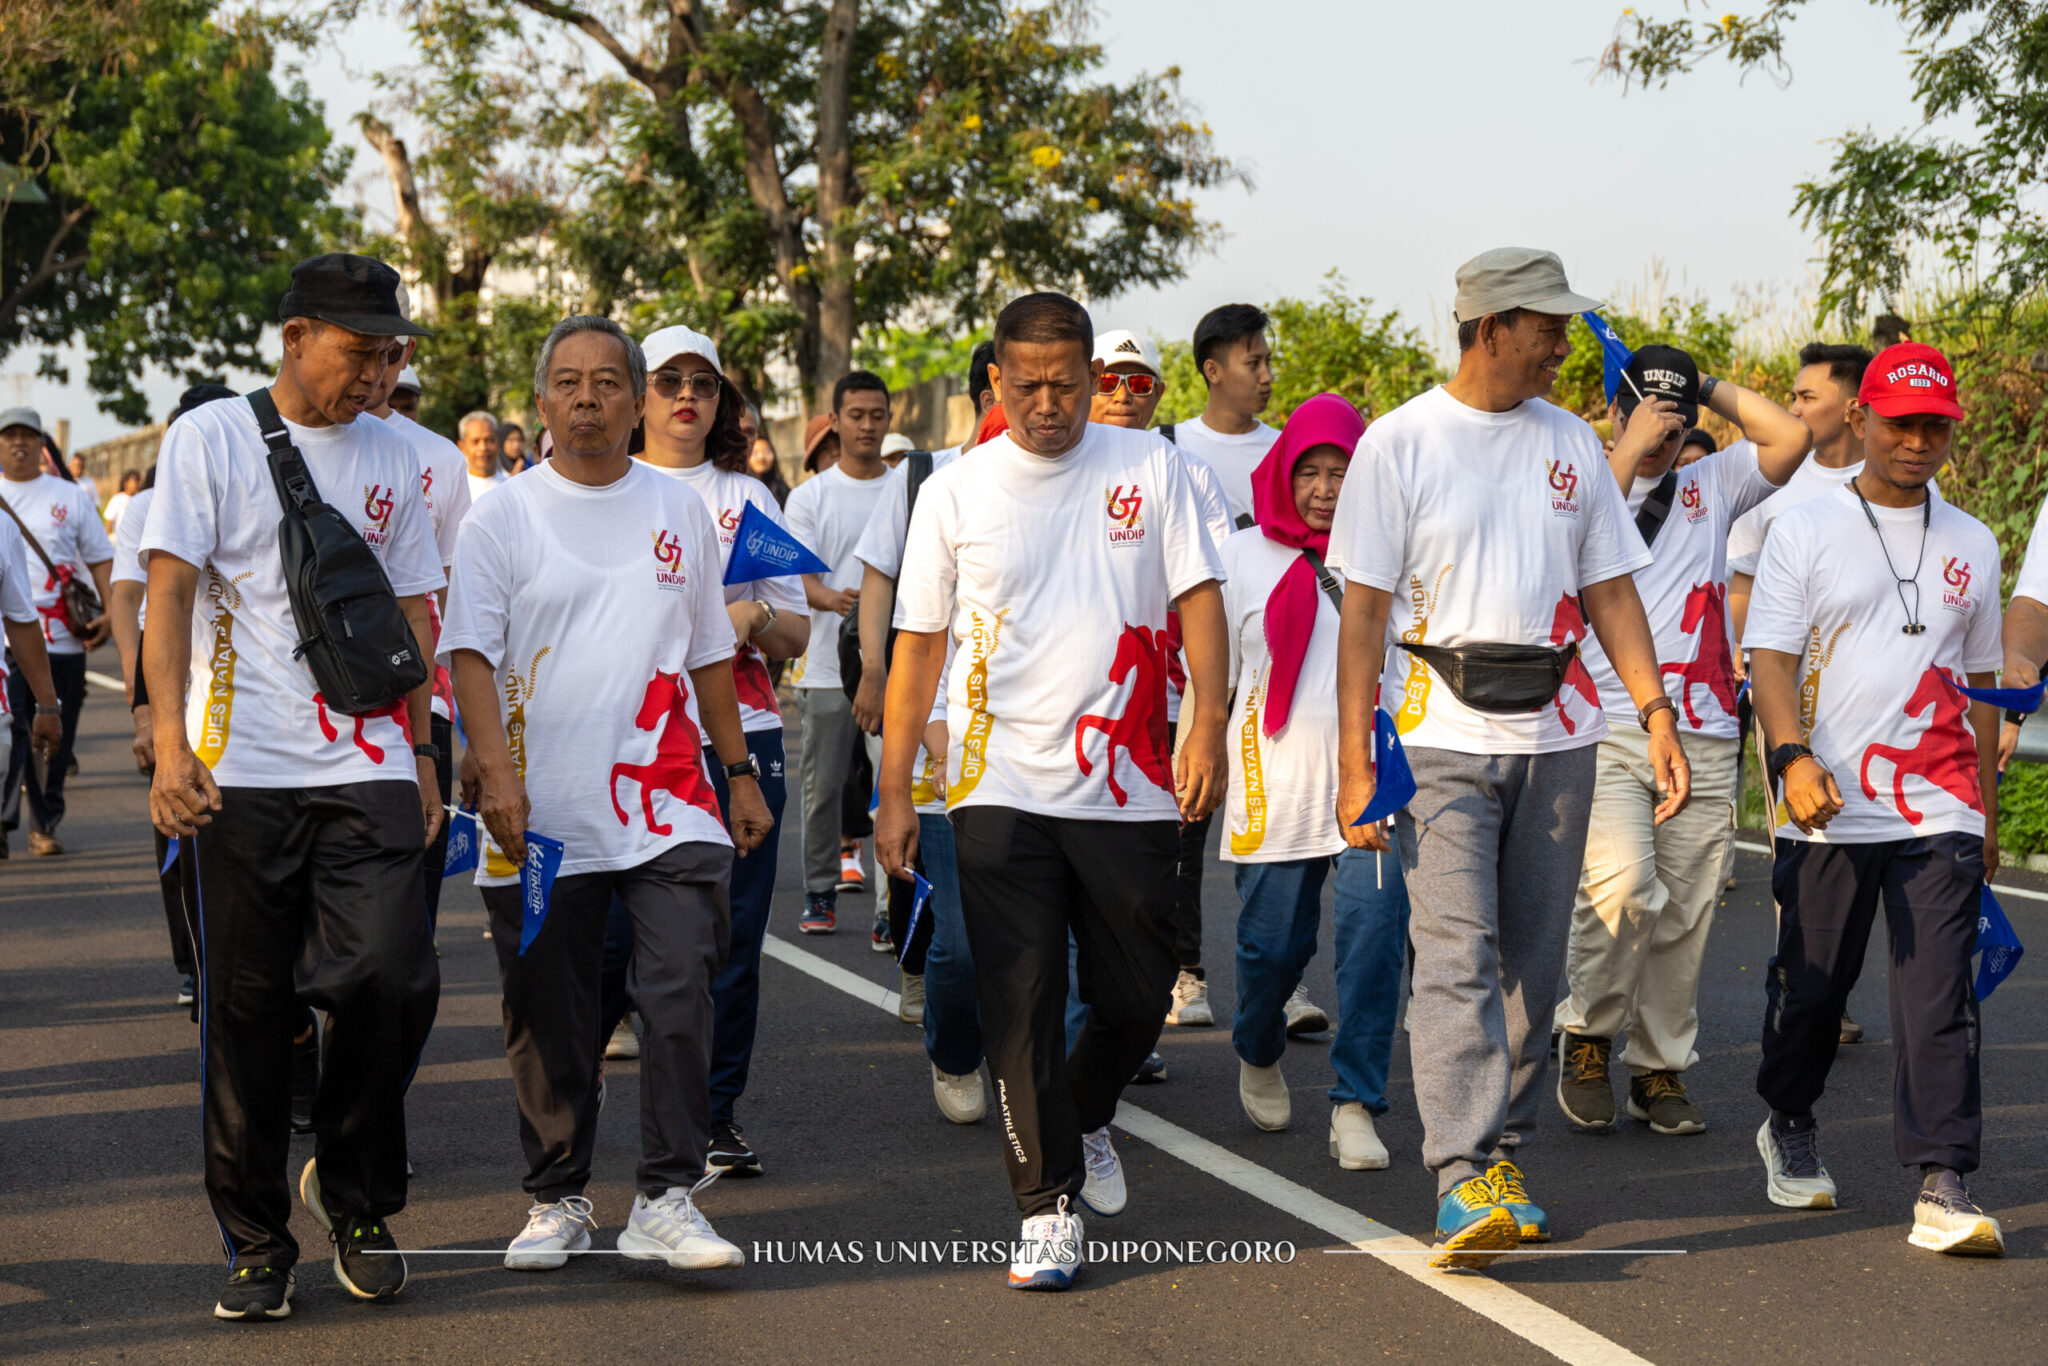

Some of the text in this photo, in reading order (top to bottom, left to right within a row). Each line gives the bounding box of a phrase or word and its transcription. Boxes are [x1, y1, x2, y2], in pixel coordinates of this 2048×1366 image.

[1643, 368, 1687, 388] UNDIP
[1887, 363, 1948, 387] ROSARIO
[1551, 500, 1580, 514] UNDIP
[1109, 529, 1145, 542] UNDIP
[763, 541, 799, 562] UNDIP
[656, 572, 686, 586] UNDIP
[1410, 573, 1425, 629] UNDIP
[1943, 593, 1971, 610] UNDIP
[1407, 680, 1426, 715] DES
[206, 703, 227, 748] DIES
[964, 738, 981, 778] DIES
[1245, 723, 1259, 791] NATALIS
[1251, 796, 1262, 832] DIES
[530, 868, 541, 915] UNDIP
[1990, 945, 2006, 973] NDIP
[1002, 1103, 1027, 1163] ATHLETICS
